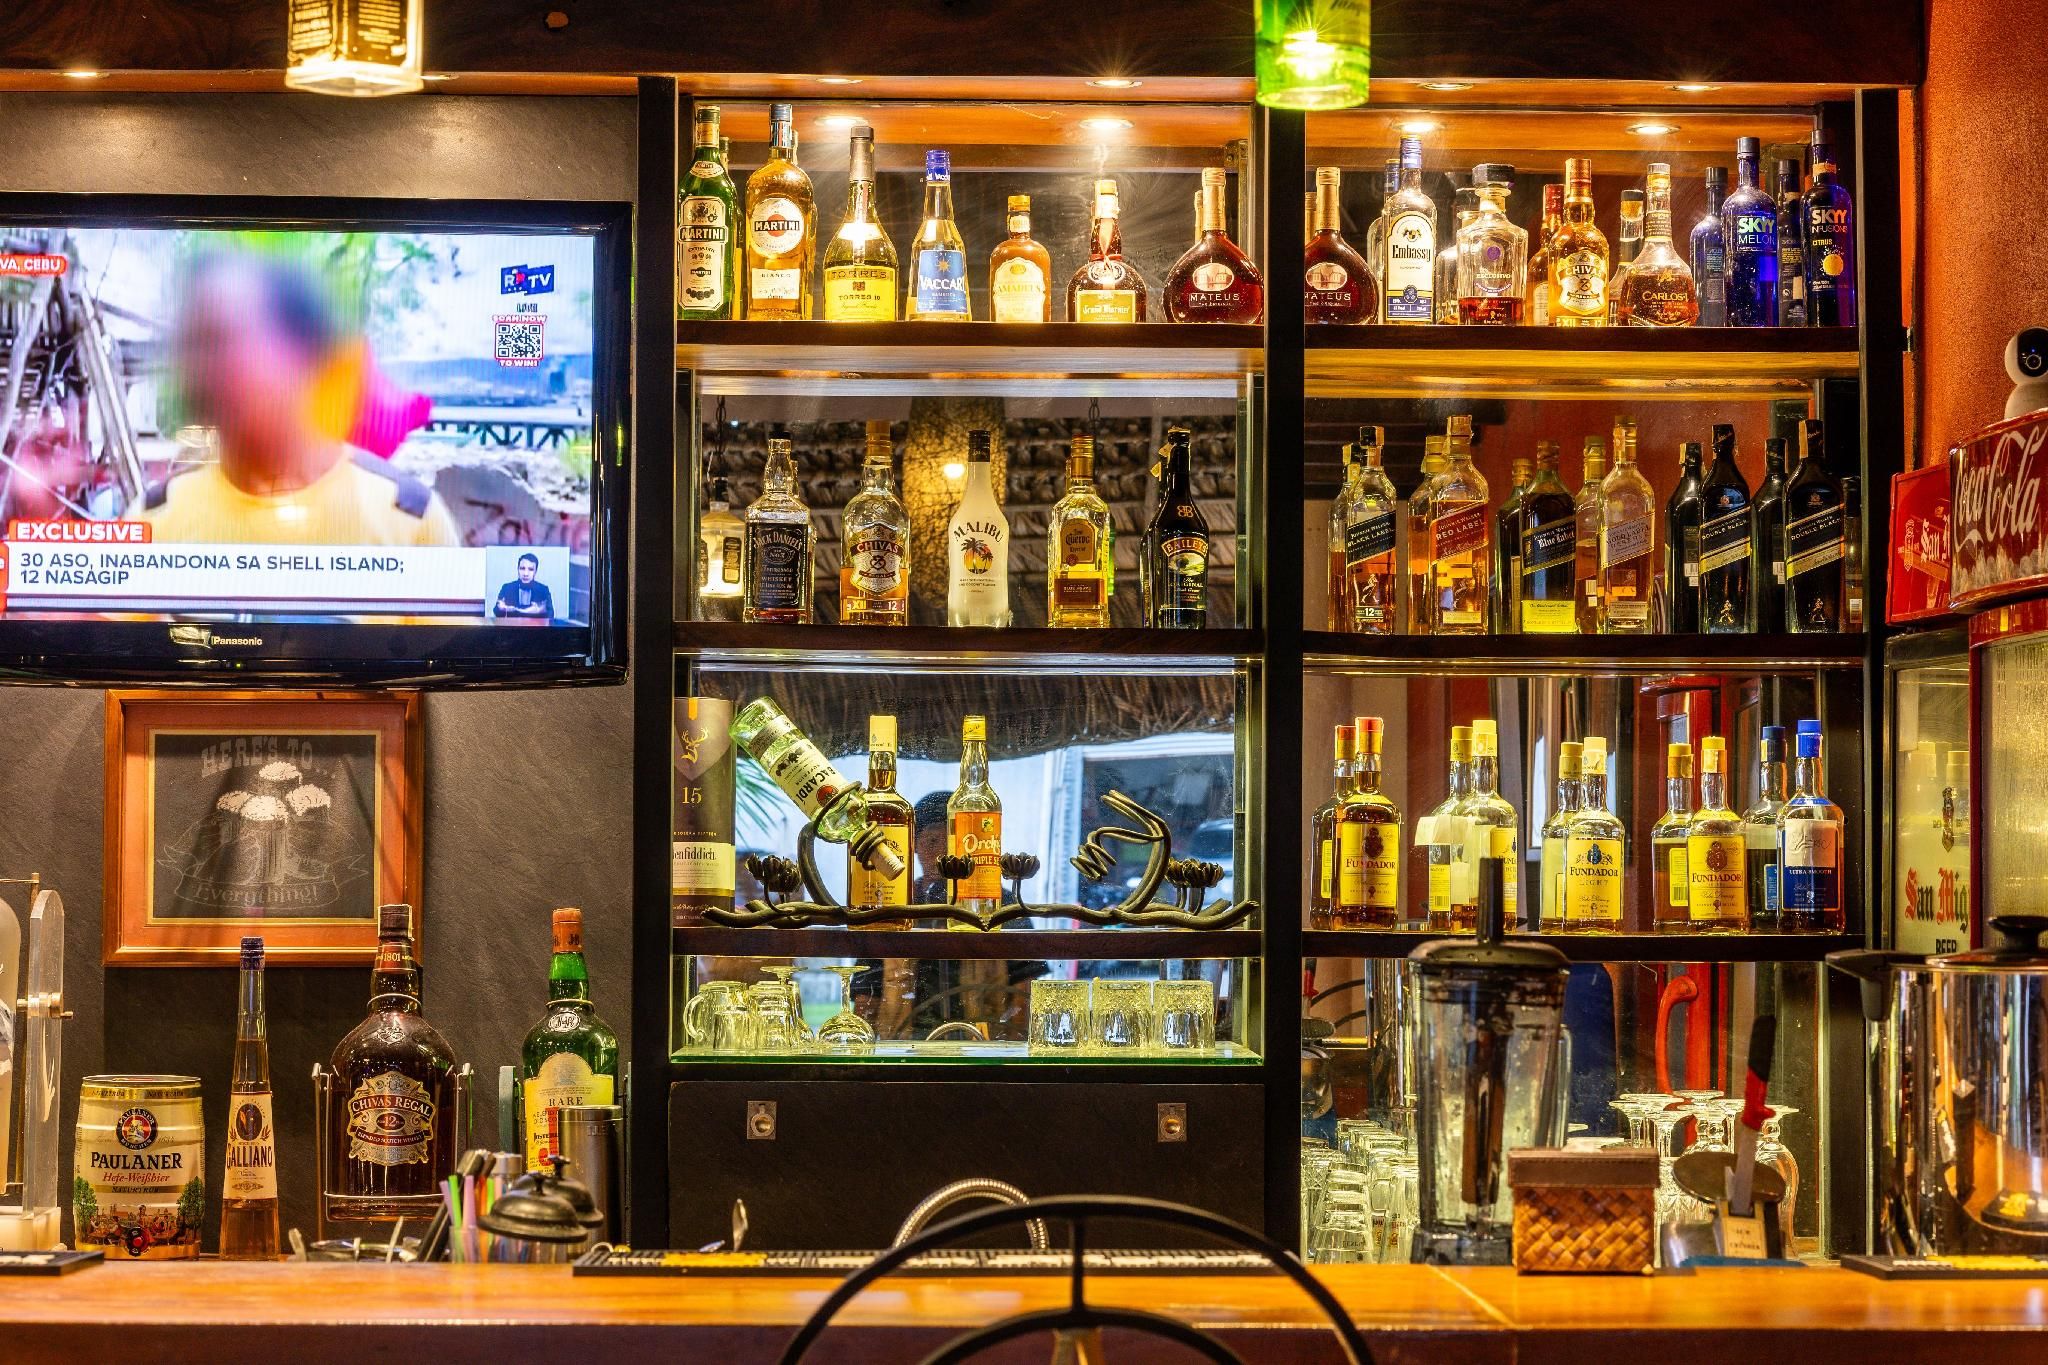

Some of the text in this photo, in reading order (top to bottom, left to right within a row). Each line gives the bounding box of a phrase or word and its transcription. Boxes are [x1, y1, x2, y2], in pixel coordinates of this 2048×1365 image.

[1811, 209, 1848, 225] SKYY
[755, 221, 800, 231] MARTINI
[1738, 216, 1775, 234] SKYY
[681, 227, 724, 241] MARTINI
[1739, 234, 1775, 245] MELON
[1392, 244, 1431, 262] Embassy
[23, 257, 61, 272] CEBU
[831, 270, 887, 279] TORRES
[1190, 293, 1240, 301] MATEUS
[16, 521, 144, 542] EXCLUSIVE
[953, 521, 1004, 543] MALIBU
[1435, 519, 1485, 541] RED LABEL
[856, 541, 899, 554] CHIVAS
[1165, 539, 1208, 553] BAILEYS
[1920, 518, 1940, 563] San
[20, 552, 405, 573] 30 ASO, INABANDONA SA SHELL ISLAND;
[20, 569, 130, 585] 12 NASAGIP
[1365, 607, 1375, 617] 12
[212, 635, 264, 647] Panasonic
[201, 736, 278, 778] HERE'S
[682, 786, 702, 805] 15
[971, 855, 993, 866] RIPLE
[1691, 872, 1743, 883] FUNDADOR
[1905, 866, 1934, 922] San
[1935, 938, 1957, 953] BEER
[383, 952, 400, 962] 1801
[352, 1095, 430, 1117] CHIVAS REGAL
[548, 1096, 584, 1107] RARE
[118, 1108, 156, 1125] PAULANER
[384, 1115, 397, 1128] 12
[90, 1151, 183, 1170] PAULANER
[226, 1143, 273, 1170] GALLIANO
[102, 1171, 171, 1186] Hefe-Weißbier
